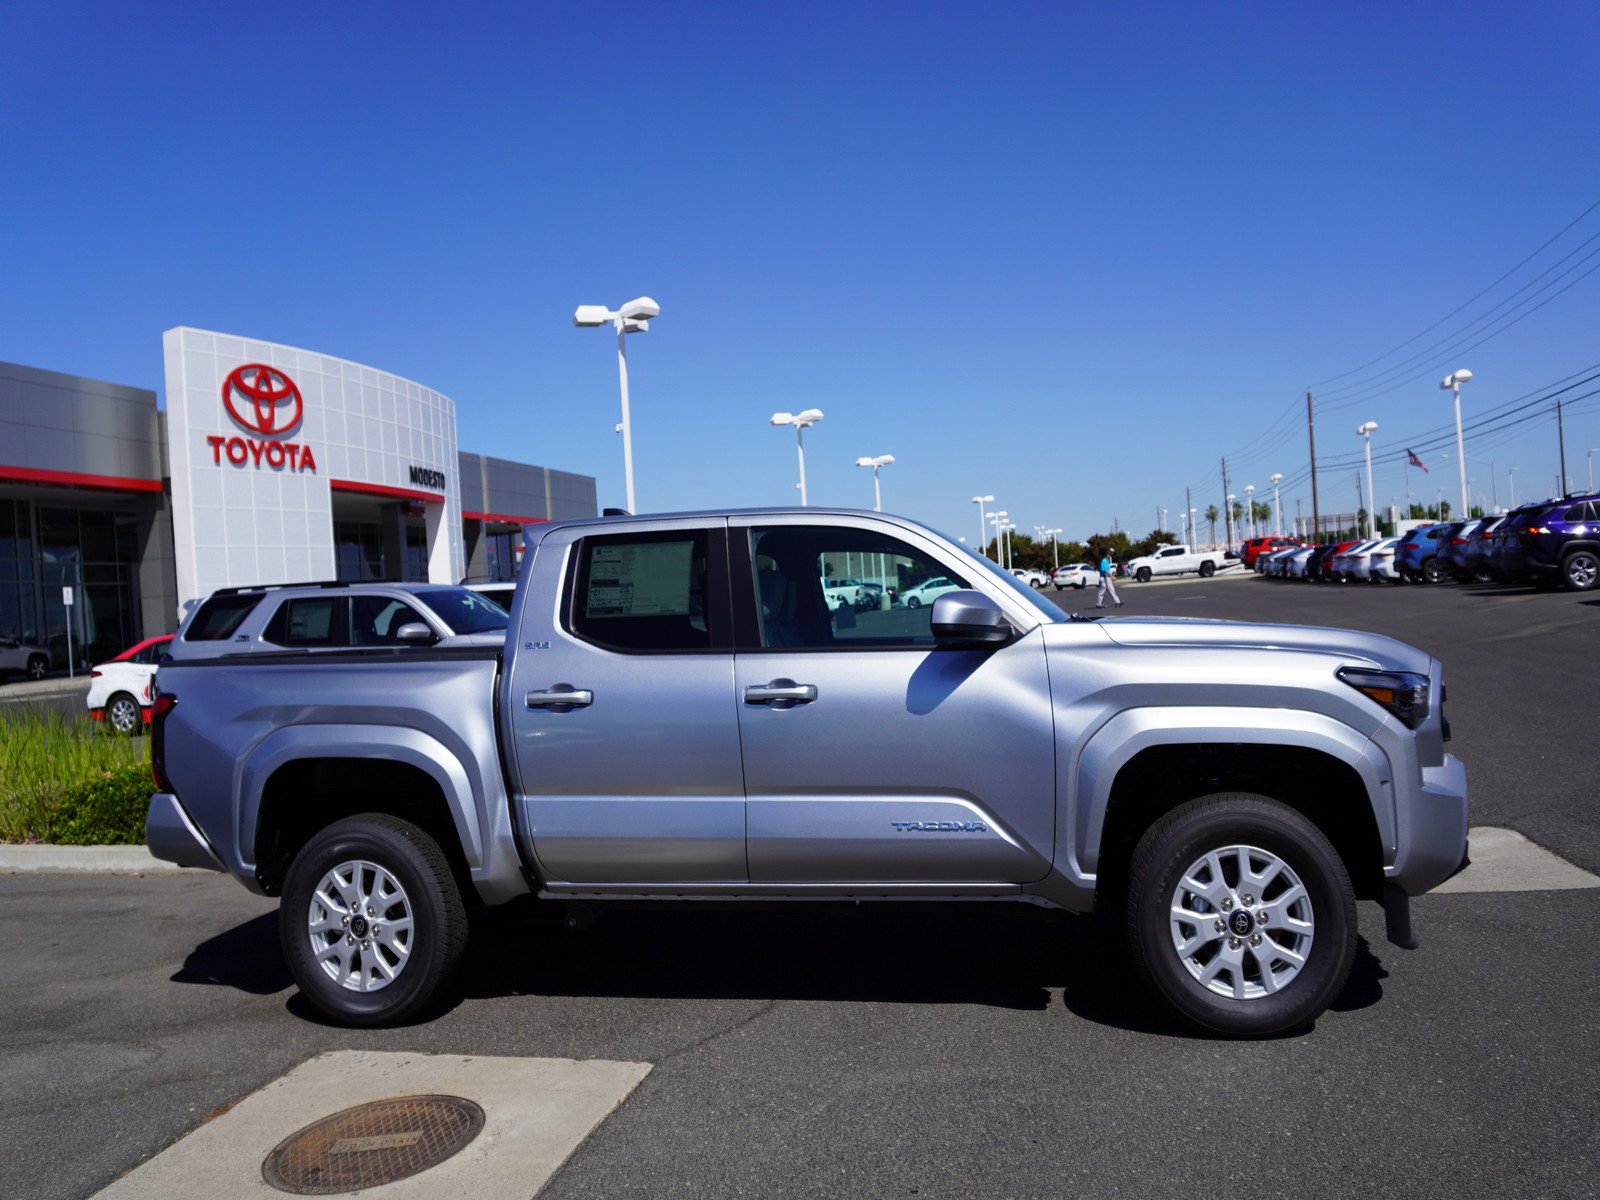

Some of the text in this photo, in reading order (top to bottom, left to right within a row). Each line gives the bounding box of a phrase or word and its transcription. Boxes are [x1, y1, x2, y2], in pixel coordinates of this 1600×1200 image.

[207, 435, 317, 473] TOYOTA
[409, 465, 445, 490] MODESTO
[891, 821, 987, 832] TACOMA
